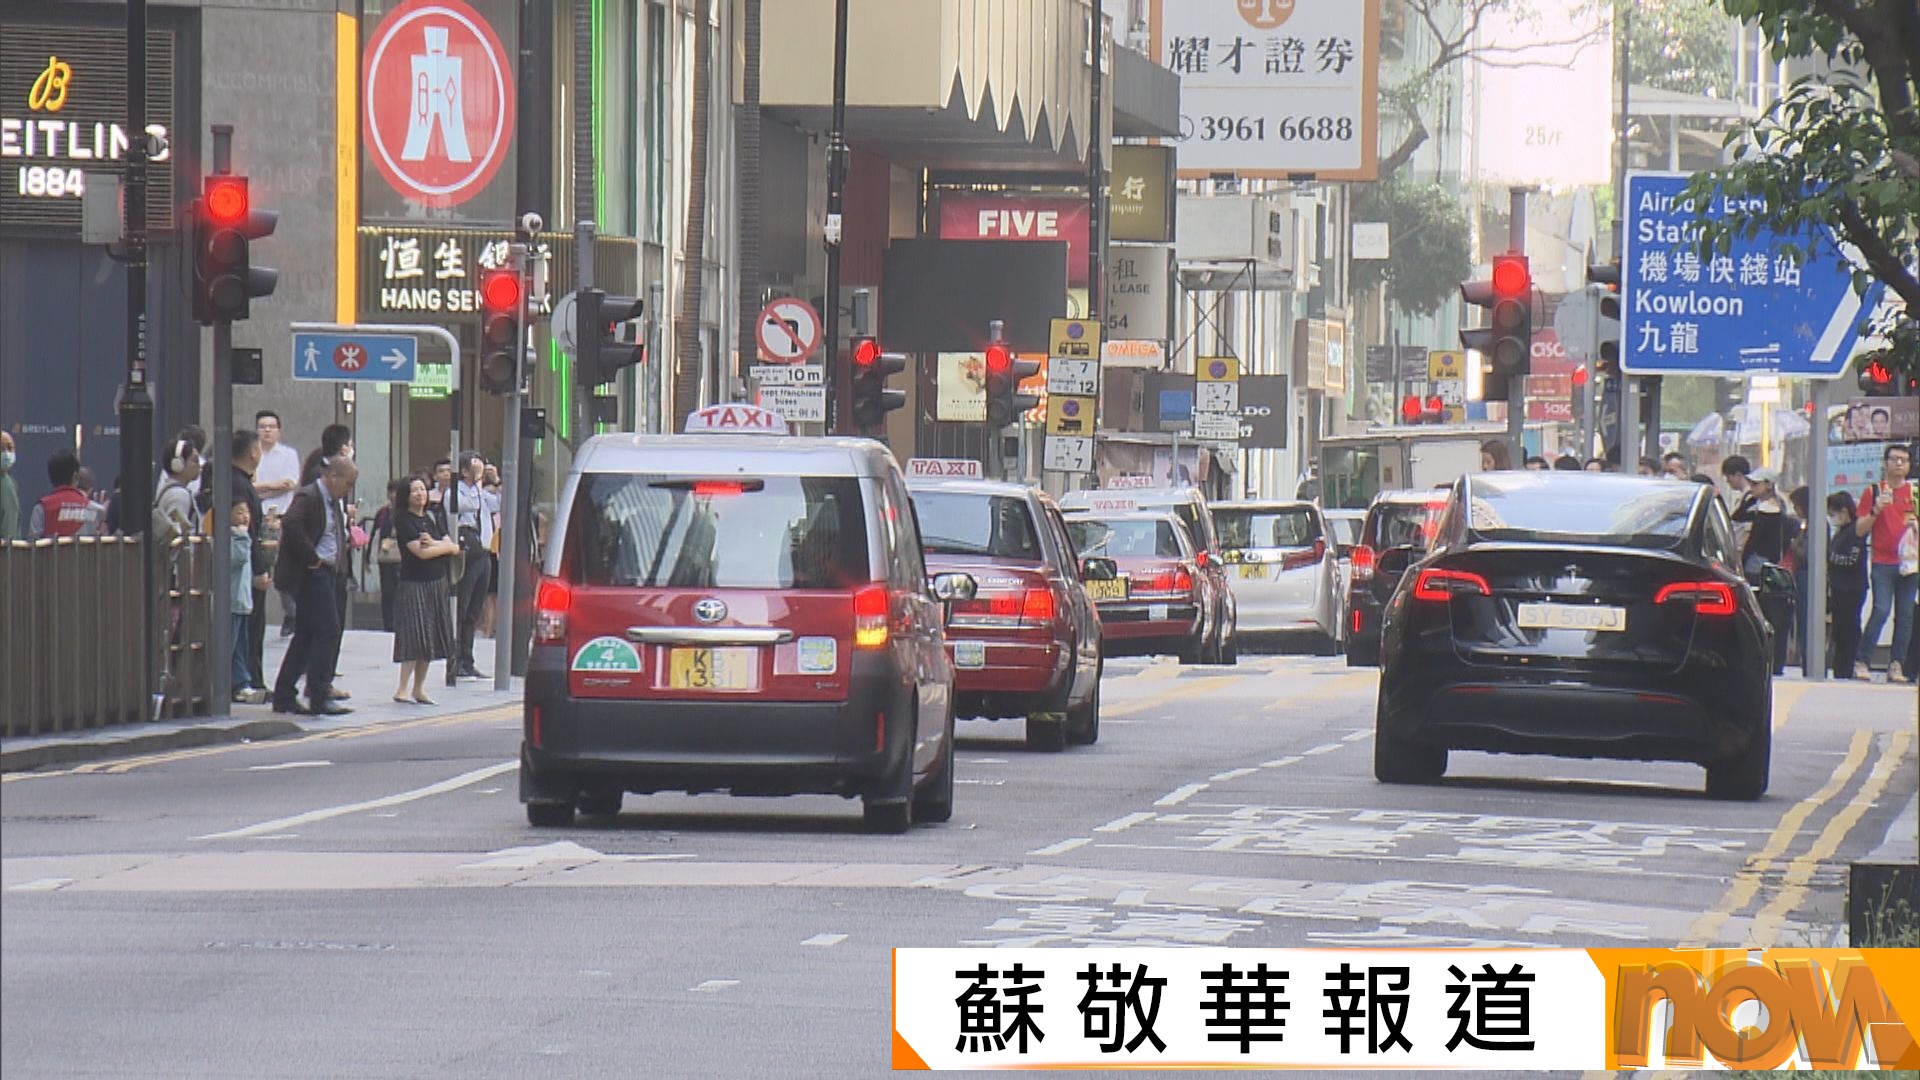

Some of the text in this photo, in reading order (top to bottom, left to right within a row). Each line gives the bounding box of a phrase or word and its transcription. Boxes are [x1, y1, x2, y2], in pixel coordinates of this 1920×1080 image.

[1169, 36, 1354, 75] 耀才證券
[1200, 116, 1353, 141] 3961 6688
[19, 166, 83, 197] 1884
[1121, 176, 1147, 200] 行
[978, 209, 1058, 237] FIVE
[1112, 257, 1139, 281] 租
[1639, 250, 1801, 286] 機場快綫站
[381, 288, 442, 310] HANG
[1112, 284, 1150, 294] LEASE
[1635, 288, 1743, 316] Kowloon
[1637, 319, 1699, 355] 九龍
[1108, 342, 1160, 356] OMEGA
[788, 368, 804, 381] 10
[807, 370, 820, 380] m
[1079, 380, 1095, 394] 12
[700, 408, 773, 428] TAXI
[912, 460, 977, 476] TAXI
[1111, 478, 1151, 487] TAXI
[1094, 499, 1135, 510] TAXI
[600, 648, 615, 661] 4
